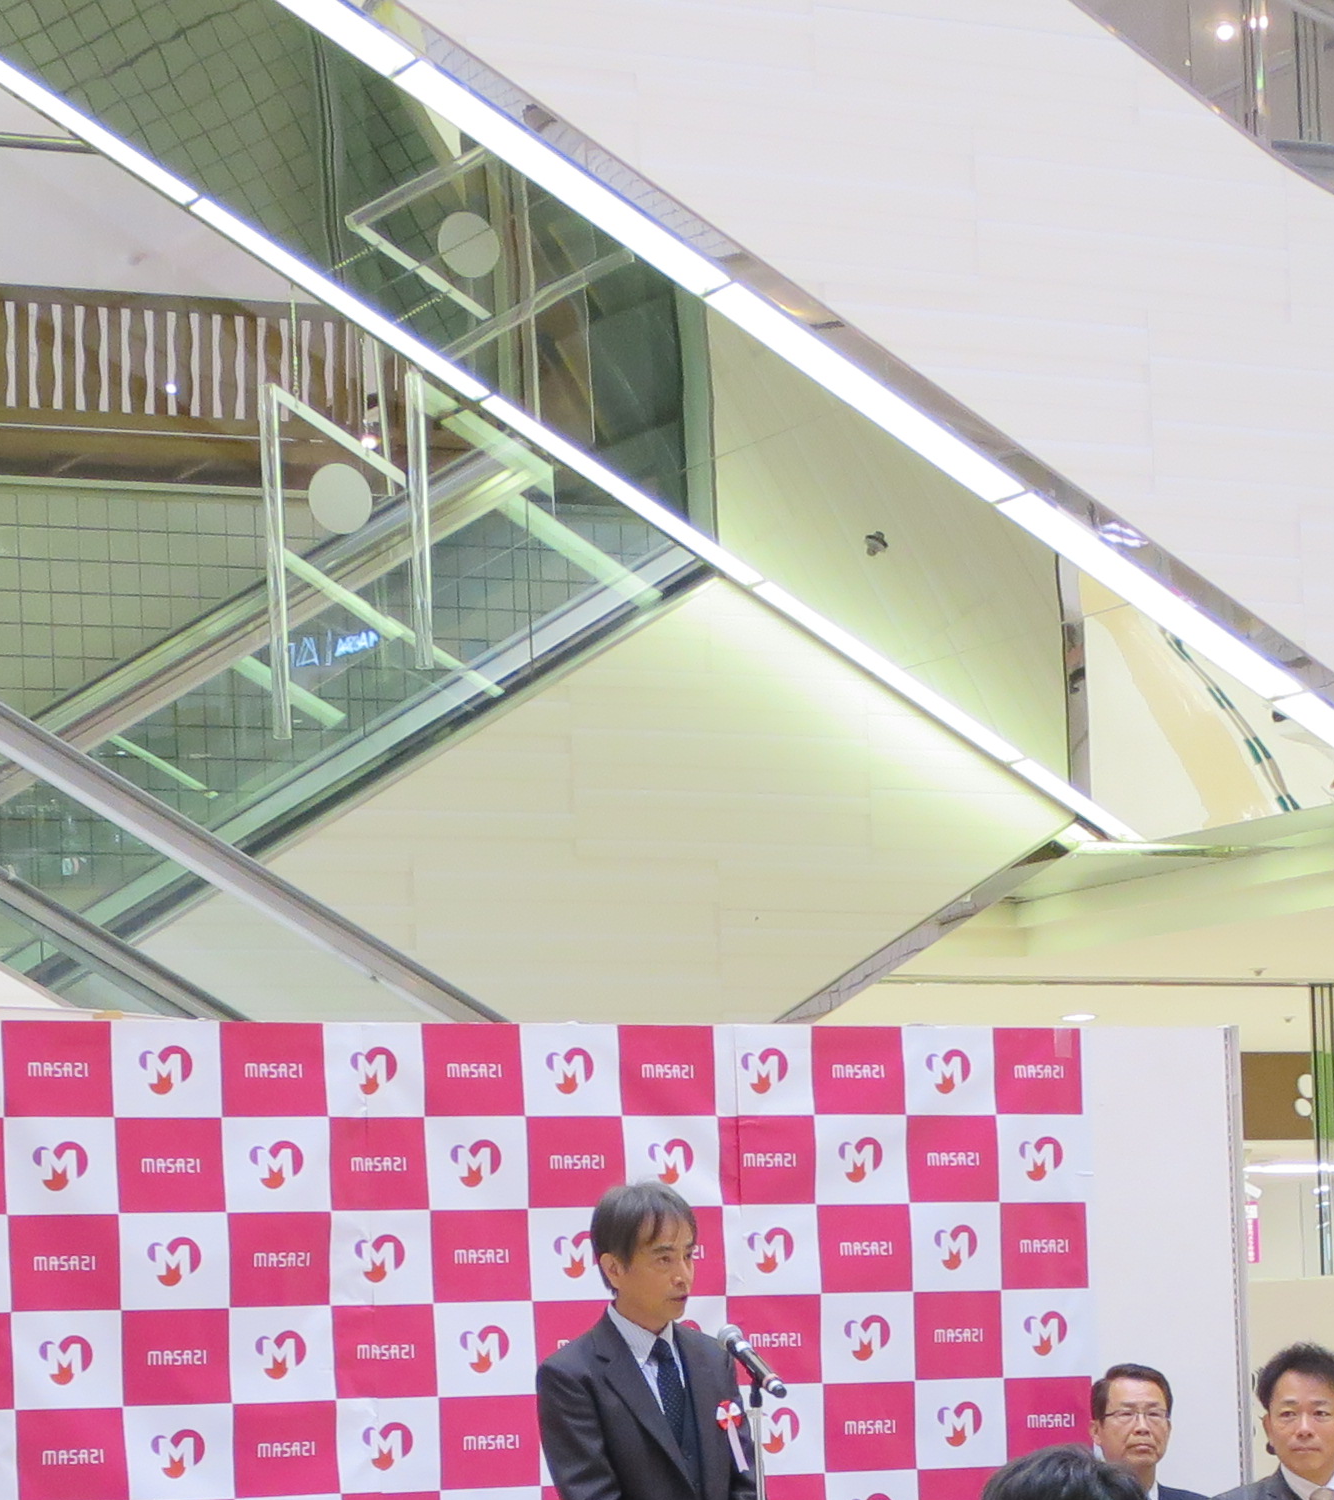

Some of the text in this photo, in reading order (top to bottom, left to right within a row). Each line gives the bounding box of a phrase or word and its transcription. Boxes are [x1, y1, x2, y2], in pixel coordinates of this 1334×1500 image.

[26, 1061, 90, 1078] MASA21
[243, 1062, 304, 1079] MASA21
[445, 1062, 503, 1079] MASA21
[640, 1063, 695, 1080] MASA21
[831, 1063, 886, 1080] MASA21
[1013, 1063, 1065, 1080] MASA21
[140, 1157, 201, 1174] MASA21
[350, 1156, 408, 1173] MASA21
[549, 1153, 606, 1170] MASA21
[742, 1152, 798, 1168] MASA21
[926, 1151, 981, 1167] MASA21
[838, 1240, 894, 1257] MASA21
[1018, 1238, 1070, 1254] MASA21
[32, 1255, 96, 1272] MASA21
[253, 1251, 311, 1268] MASA21
[453, 1248, 510, 1265] MASA21
[933, 1327, 984, 1344] MASA21
[147, 1348, 208, 1366] MASA21
[356, 1343, 416, 1361] MASA21
[844, 1418, 897, 1436] MASA21
[1026, 1413, 1075, 1429] MASA21
[257, 1440, 316, 1458] MASA21
[462, 1433, 520, 1451] MASA21
[41, 1448, 105, 1466] MASA21
